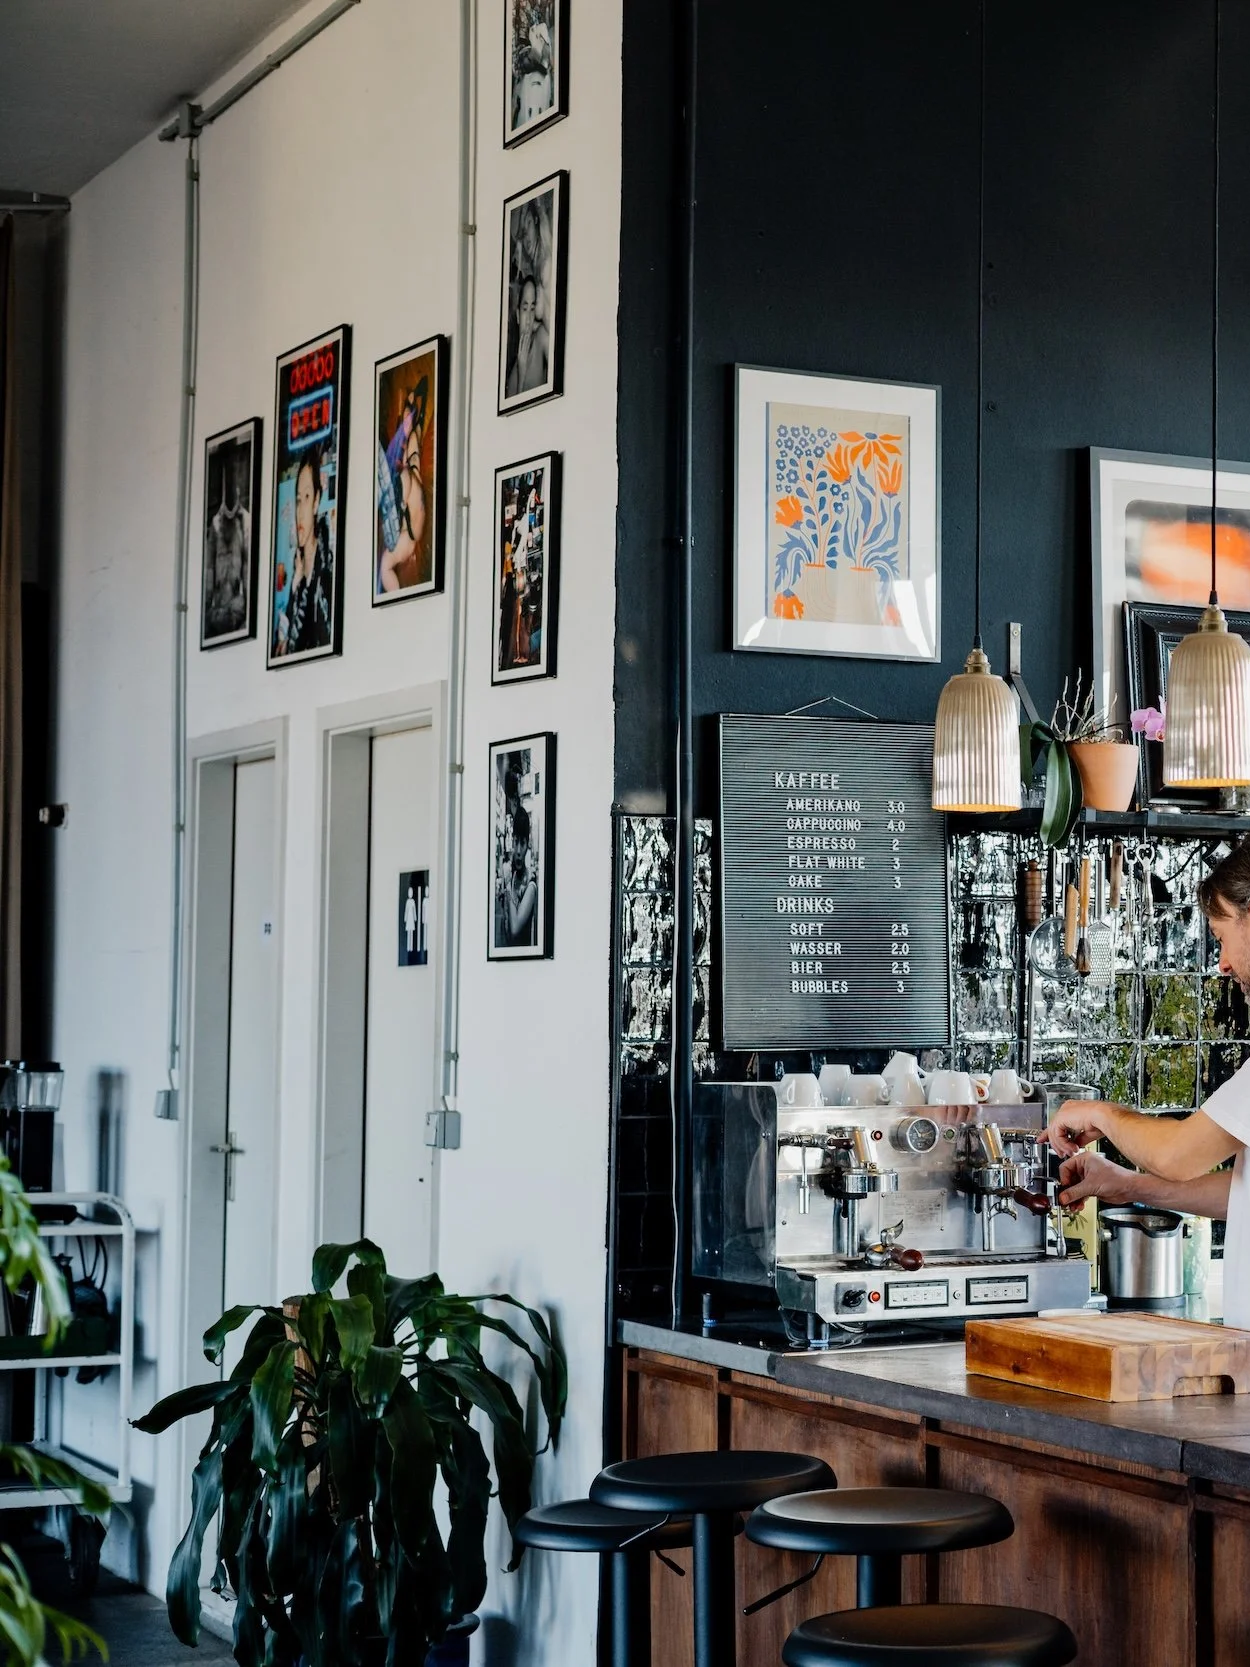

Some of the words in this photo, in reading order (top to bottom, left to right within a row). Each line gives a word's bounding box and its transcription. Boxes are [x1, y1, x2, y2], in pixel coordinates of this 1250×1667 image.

[775, 771, 840, 789] KAFFEE
[786, 798, 861, 813] AMERIKANO
[887, 801, 905, 813] 3.0
[786, 817, 862, 832] CAPPUCCINO
[887, 819, 906, 832] 4.0
[787, 836, 856, 850] ESPRESSO
[892, 838, 900, 851] 2
[788, 855, 820, 868] FLAT
[827, 856, 866, 869] WHITE
[893, 857, 901, 870] 3
[788, 875, 822, 888] CAKE
[894, 876, 902, 889] 3
[776, 897, 835, 913] DRINKS
[790, 922, 824, 936] SOFT
[891, 923, 909, 936] 2.5
[790, 942, 842, 955] WASSER
[891, 942, 910, 955] 2.0
[791, 961, 823, 974] BIER
[891, 961, 911, 974] 2.5
[792, 980, 849, 993] BUBBLES
[897, 980, 905, 993] 3
